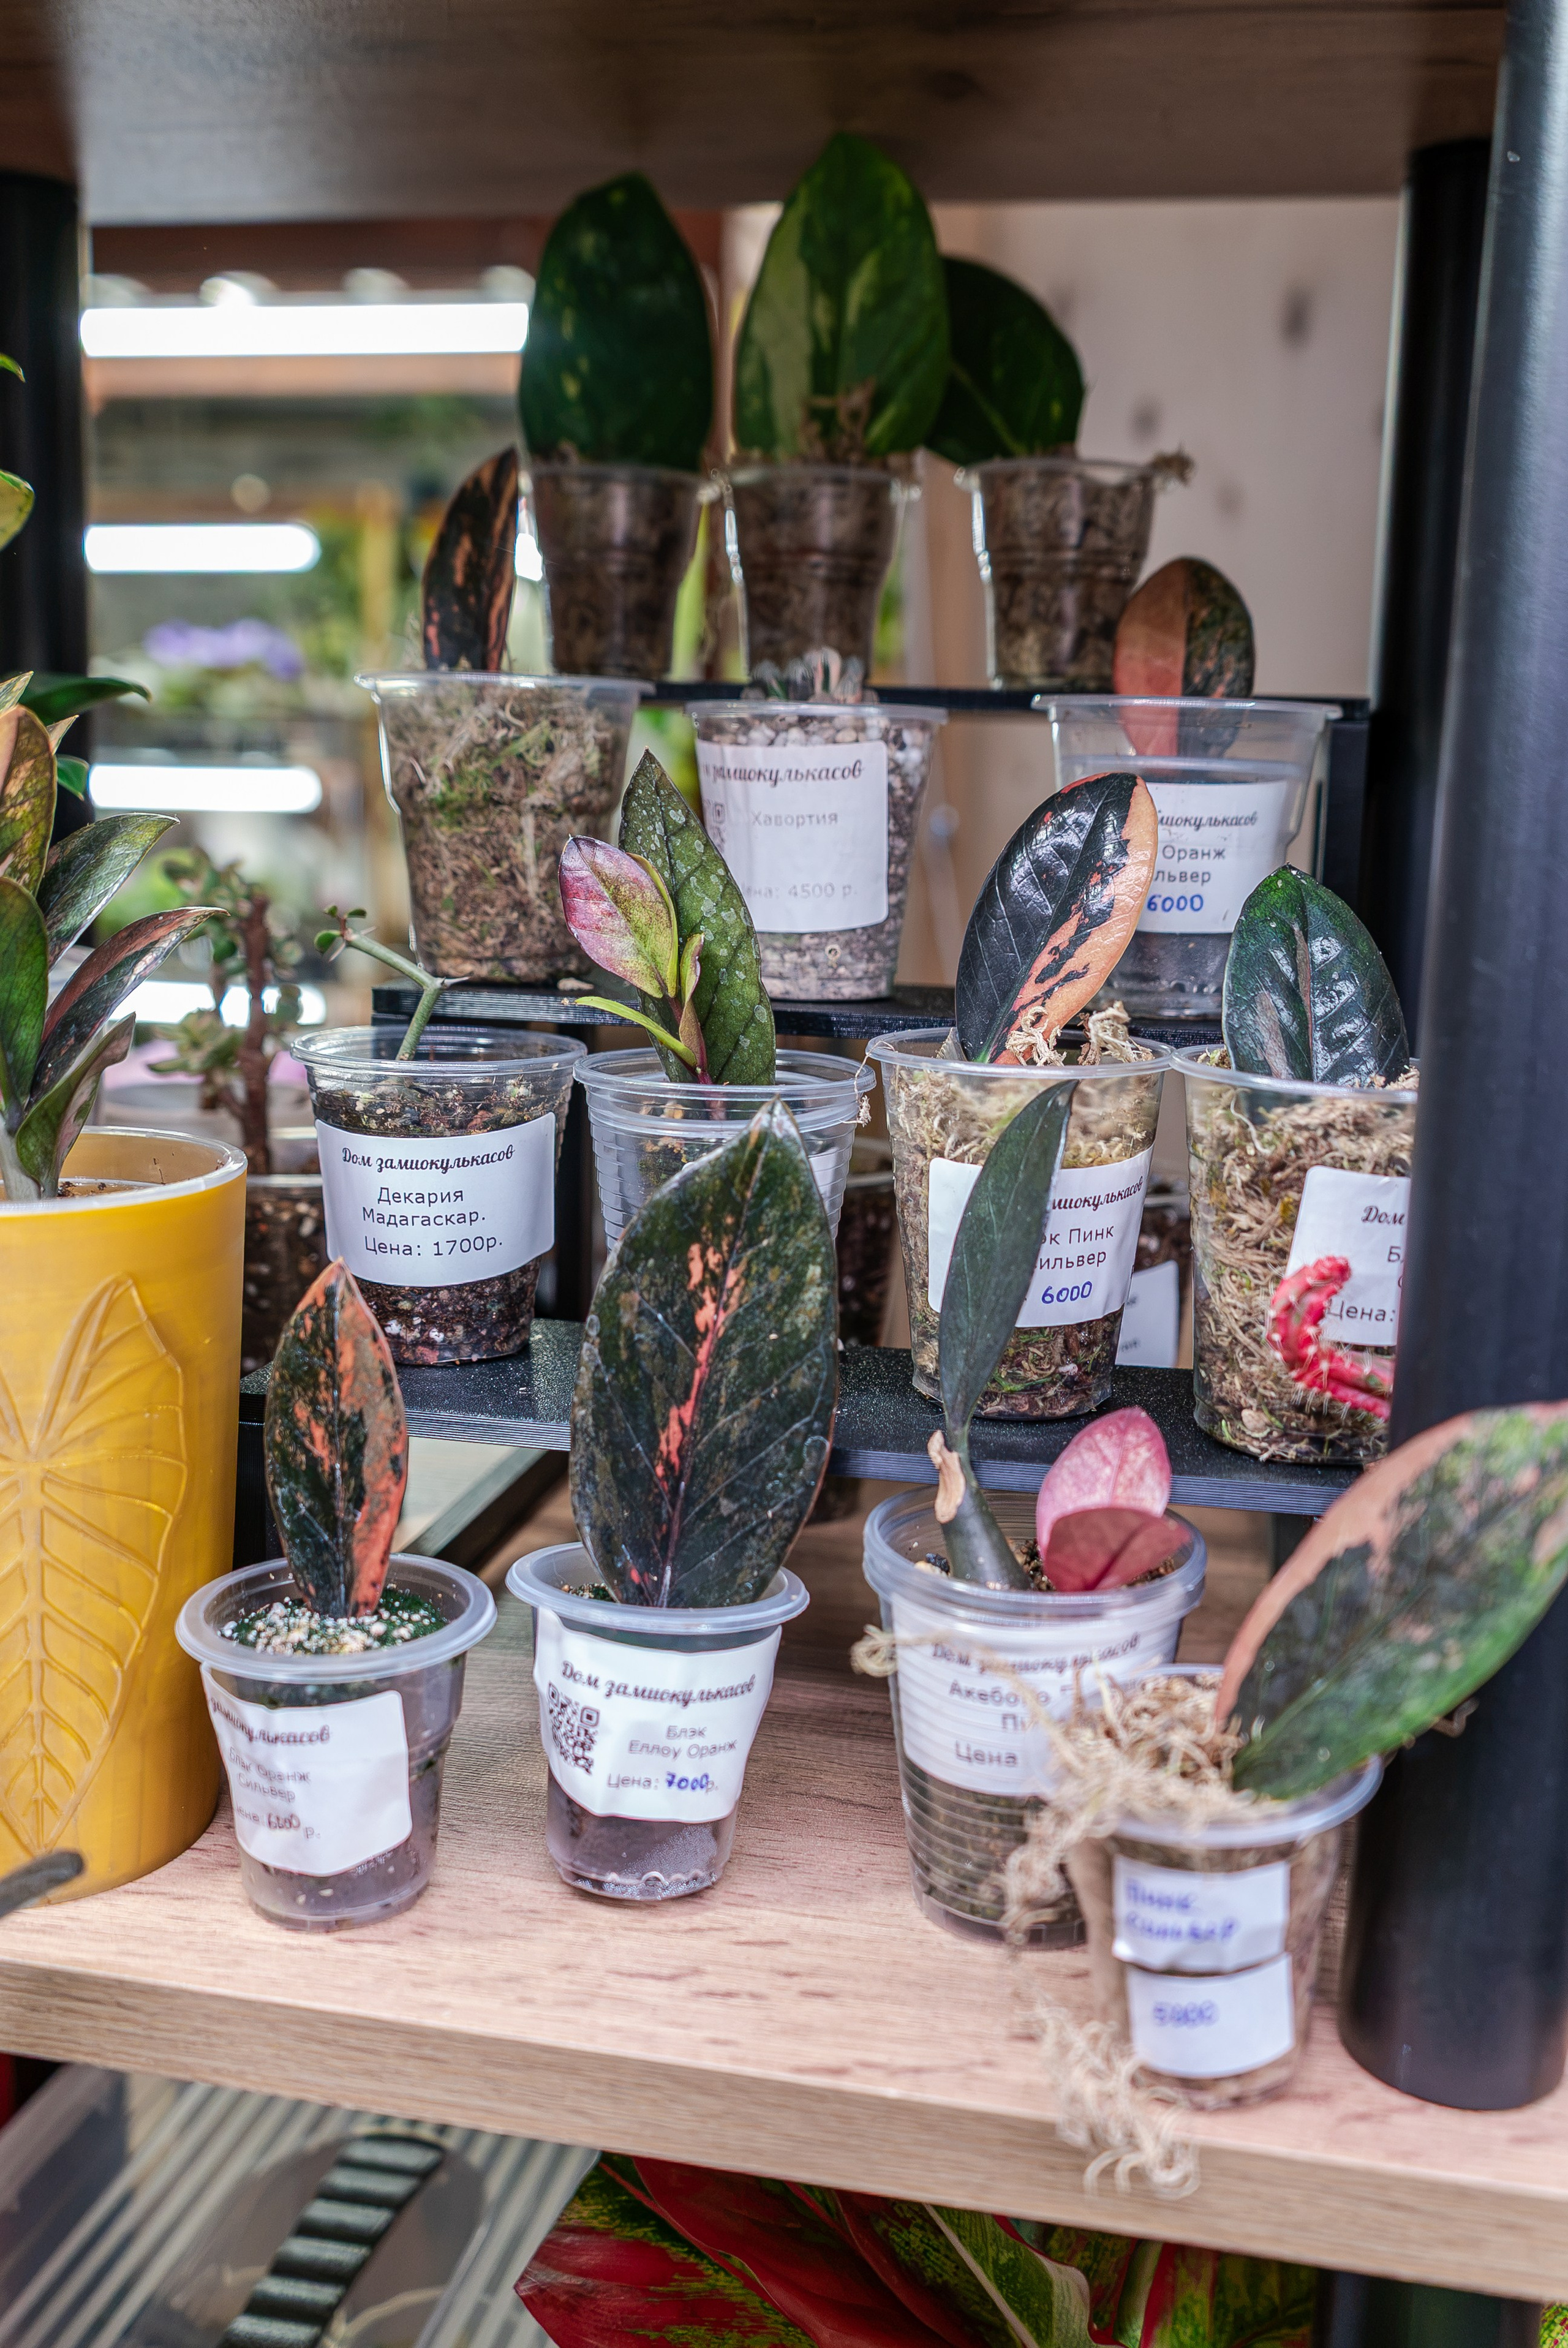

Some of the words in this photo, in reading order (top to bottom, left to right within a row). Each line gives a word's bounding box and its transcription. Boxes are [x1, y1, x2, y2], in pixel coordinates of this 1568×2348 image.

[752, 811, 839, 829] Хавортия
[1162, 845, 1226, 863] Оранж
[1153, 870, 1211, 886] львер
[788, 882, 835, 899] 4500
[1147, 894, 1204, 913] 6000
[342, 1147, 372, 1167] Дом
[375, 1144, 516, 1174] замиокулькасов
[377, 1187, 464, 1207] Декария
[362, 1207, 486, 1228] Мадагаскар.
[1361, 1206, 1405, 1224] Дом
[1068, 1226, 1114, 1244] Пинк
[364, 1236, 421, 1256] Цена:
[433, 1236, 503, 1256] 1700р.
[1035, 1251, 1106, 1270] ильвер
[1041, 1280, 1093, 1305] 6000
[1326, 1299, 1395, 1322] Цена:
[561, 1660, 600, 1689] Дом
[604, 1674, 756, 1708] замиокулькасов
[949, 1679, 1051, 1707] Акебоо
[666, 1724, 707, 1740] Блэк
[628, 1740, 682, 1759] Еллоу
[686, 1738, 738, 1761] Оранж
[257, 1764, 311, 1783] Оранж
[606, 1773, 659, 1789] Цена:
[238, 1772, 296, 1803] Сильвер
